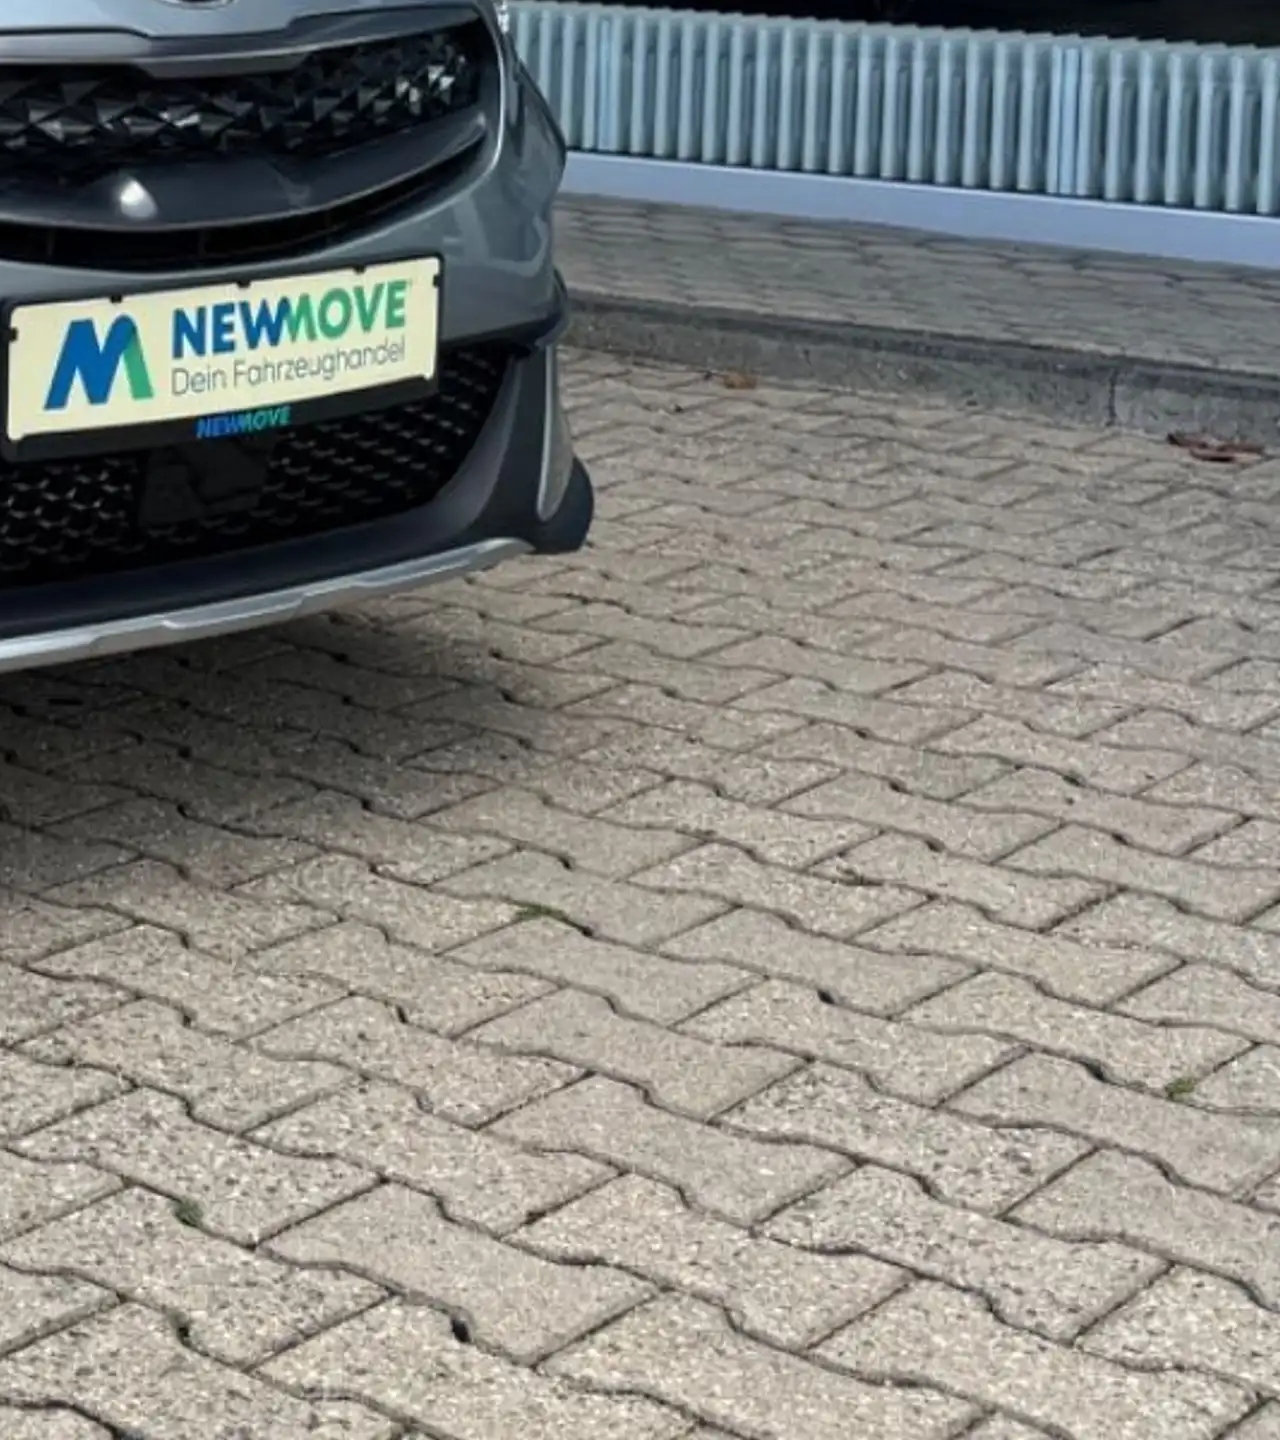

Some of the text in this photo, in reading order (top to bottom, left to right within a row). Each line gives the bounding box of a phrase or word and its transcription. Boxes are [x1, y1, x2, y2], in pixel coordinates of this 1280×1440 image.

[172, 280, 407, 358] NEWMOVE
[171, 336, 406, 396] Dein Fahrzeughandel
[195, 405, 292, 439] NEWMOVE
